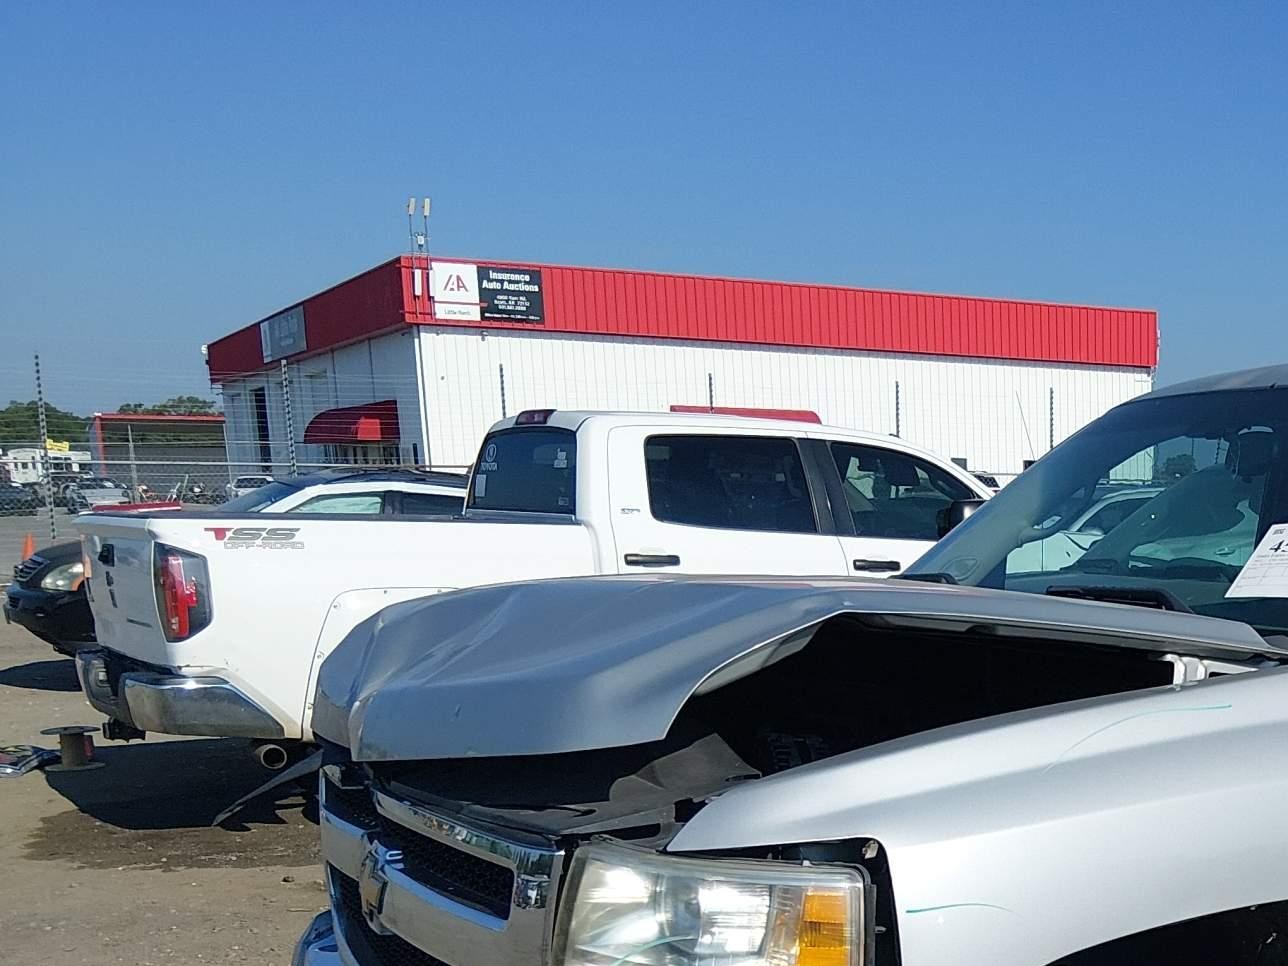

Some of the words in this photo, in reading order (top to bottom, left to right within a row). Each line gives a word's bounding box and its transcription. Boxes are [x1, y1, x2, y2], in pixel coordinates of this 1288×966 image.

[489, 270, 530, 282] Insurance
[482, 279, 502, 290] Auto
[503, 281, 539, 292] Auctions
[204, 527, 301, 541] TSS
[224, 541, 305, 549] OFF-ROAD
